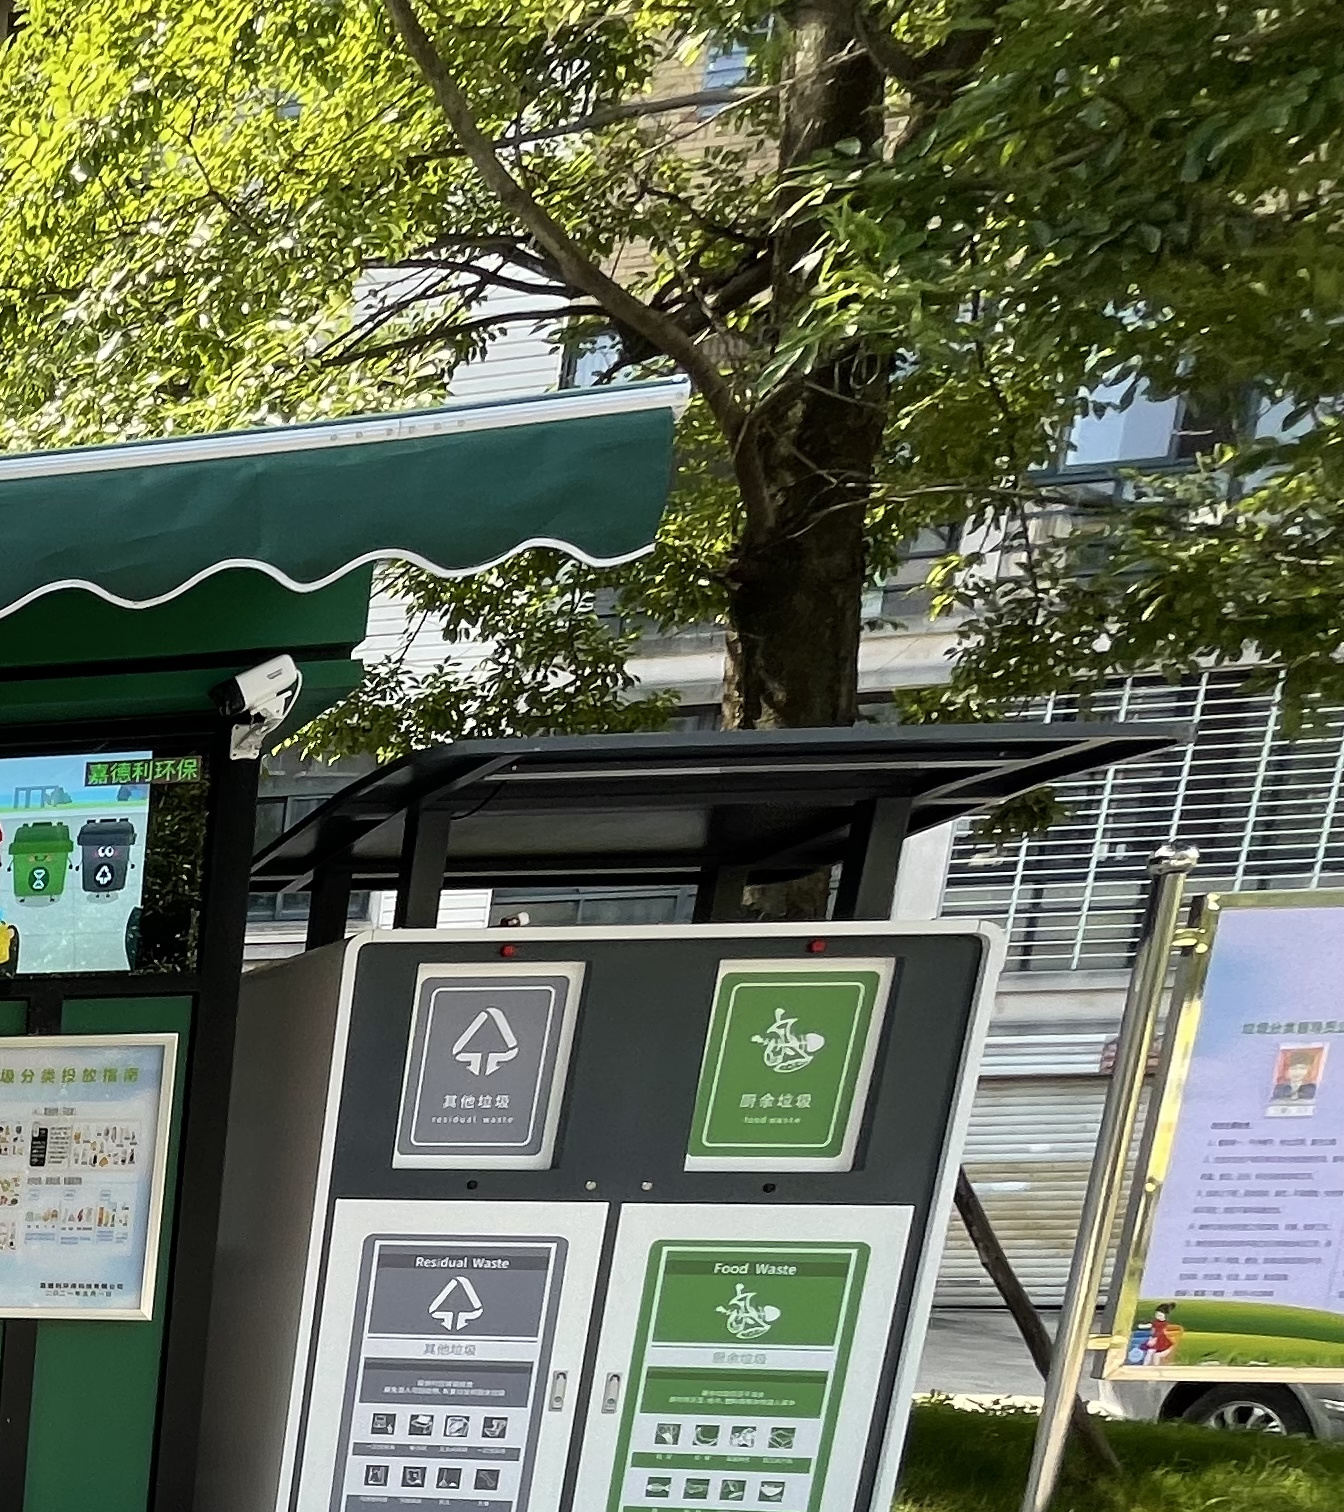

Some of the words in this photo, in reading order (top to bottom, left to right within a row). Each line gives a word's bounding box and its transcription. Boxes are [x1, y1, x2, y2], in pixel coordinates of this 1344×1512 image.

[86, 758, 199, 785] 嘉德利环保
[442, 1094, 510, 1109] 其他垃圾
[739, 1093, 812, 1109] 厨余垃圾
[415, 1256, 468, 1269] Residual
[472, 1257, 510, 1269] Waste
[713, 1262, 748, 1275] Food
[755, 1263, 797, 1275] Waste
[422, 1343, 477, 1357] 其他垃圾
